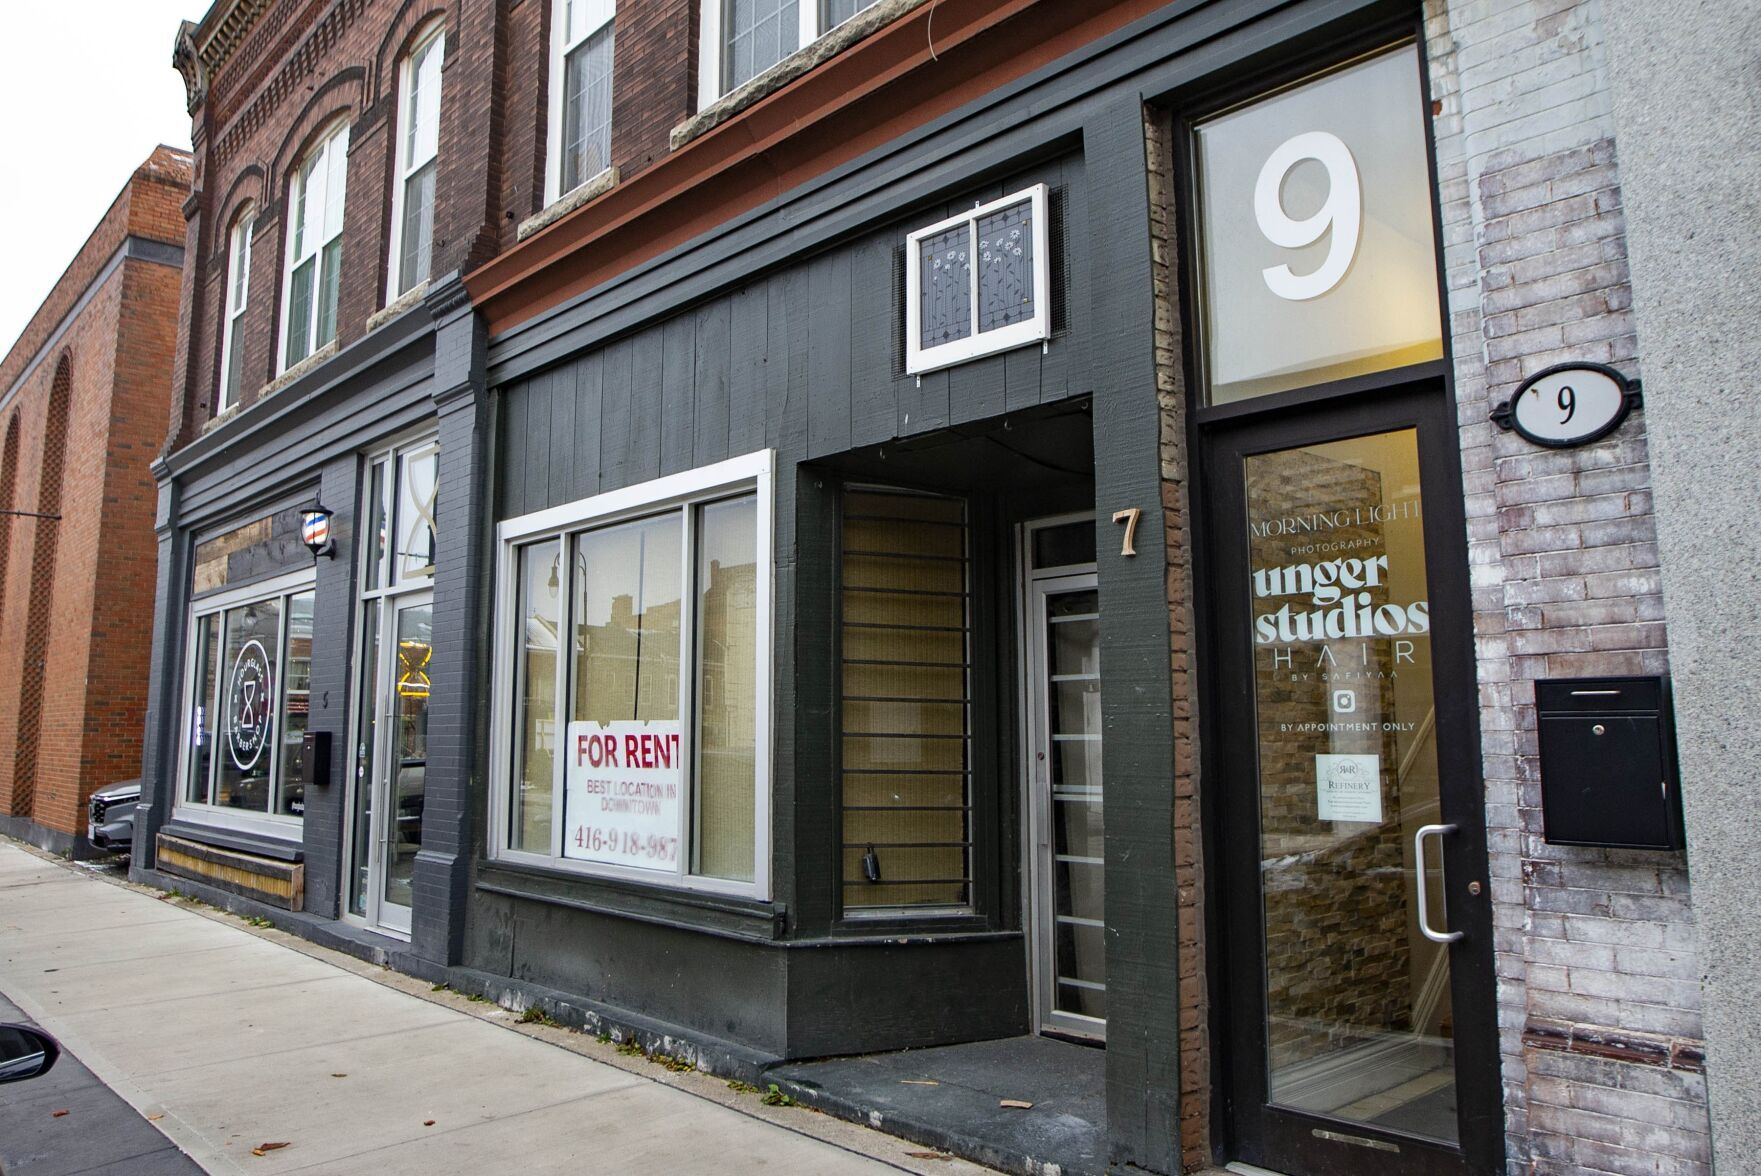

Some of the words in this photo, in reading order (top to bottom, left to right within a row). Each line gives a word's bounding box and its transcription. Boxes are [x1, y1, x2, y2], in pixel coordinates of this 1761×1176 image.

[1254, 131, 1361, 300] 9
[1557, 385, 1576, 424] 9
[1112, 508, 1140, 556] 7
[1251, 510, 1350, 538] MORNING
[1291, 537, 1380, 555] PHOTOGRAPHY
[1253, 555, 1388, 606] unger
[1256, 591, 1430, 644] studios
[1274, 640, 1415, 669] HAIR
[238, 657, 264, 686] HOURGLASS
[1291, 672, 1309, 682] BY
[1322, 670, 1398, 681] SAFIYAA
[233, 714, 263, 752] BARBERSHOP
[1280, 723, 1294, 732] BY
[1297, 722, 1377, 732] APPOINTMENT
[1382, 722, 1416, 731] ONLY
[577, 734, 619, 768] FOR
[587, 779, 612, 794] BEST
[614, 781, 663, 799] LOCATION
[666, 783, 677, 799] IN
[1328, 780, 1370, 790] REFINERY
[601, 796, 662, 816] DOWNTOWN
